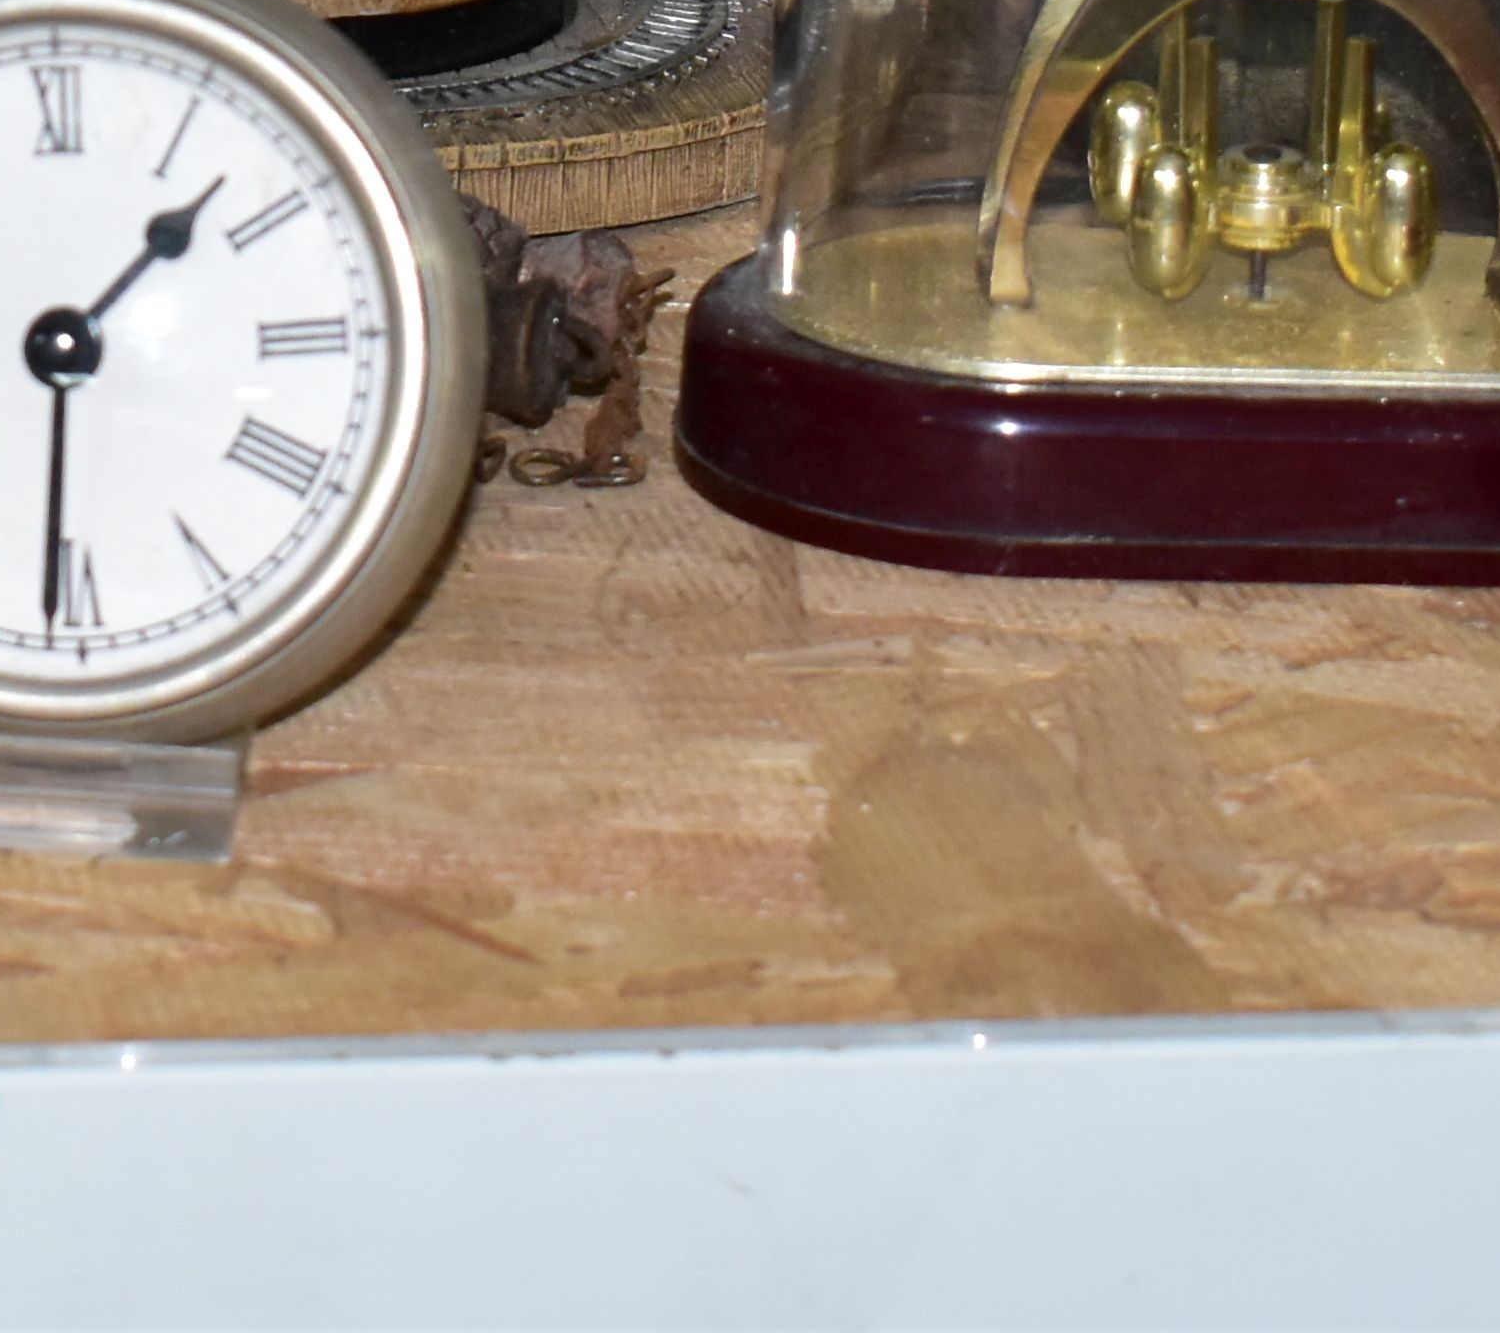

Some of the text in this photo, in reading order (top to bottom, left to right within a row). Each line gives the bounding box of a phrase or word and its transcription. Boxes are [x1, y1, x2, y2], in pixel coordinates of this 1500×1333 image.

[30, 64, 84, 156] XII
[155, 98, 200, 180] I
[224, 189, 311, 253] II
[257, 317, 348, 359] III
[225, 416, 328, 499] IIII
[171, 509, 231, 593] V
